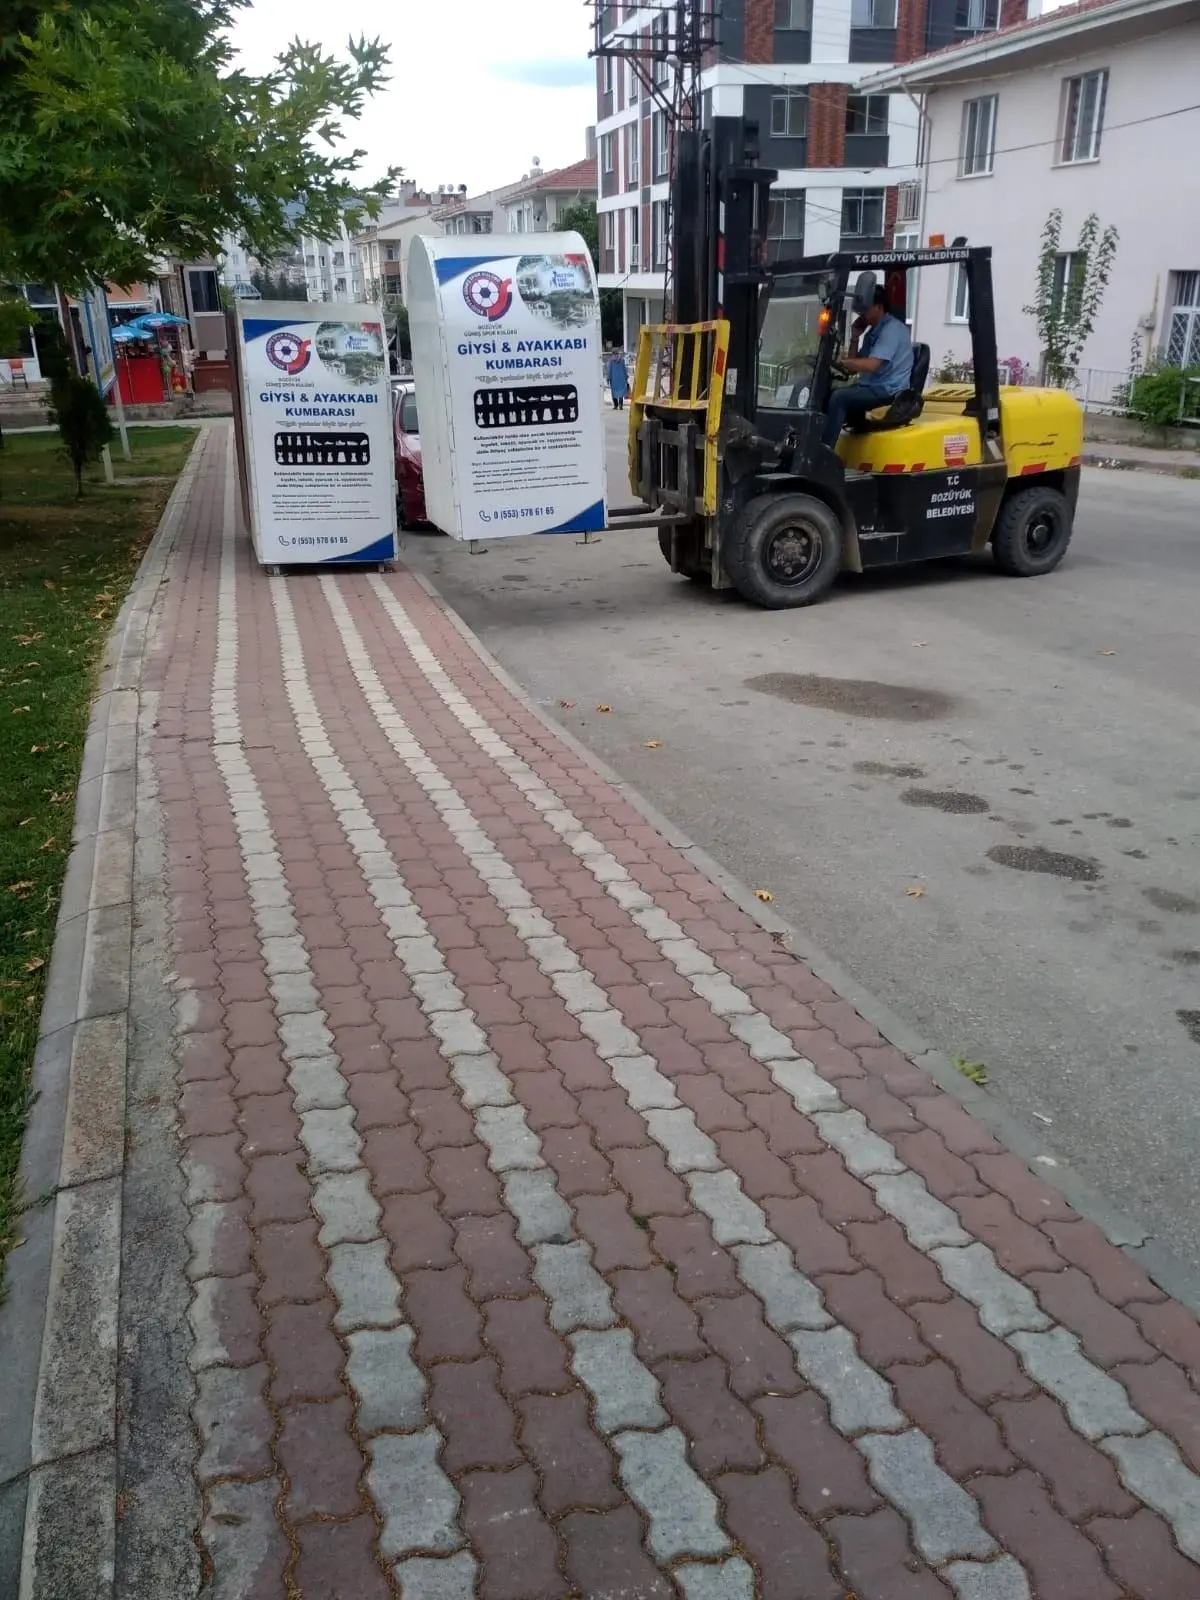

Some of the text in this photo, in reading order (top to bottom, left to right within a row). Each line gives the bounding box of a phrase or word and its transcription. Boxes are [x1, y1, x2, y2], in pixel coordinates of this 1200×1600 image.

[855, 249, 970, 264] T.C BOZÜYÜK BELEDİYESİ
[457, 338, 587, 356] GİYSİ & AYAKKABI
[485, 356, 562, 371] KUMBARASI
[259, 391, 378, 404] GİYSİ & AYAKKABI
[285, 407, 355, 417] KUMBARASI
[946, 475, 960, 486] T.C
[930, 488, 972, 503] BOZÜYÜK
[493, 511, 499, 519] 0
[500, 509, 519, 521] (553)
[535, 507, 544, 516] 61
[926, 501, 975, 519] BELEDİYESİ
[291, 537, 297, 545] 0
[298, 536, 315, 547] (553)
